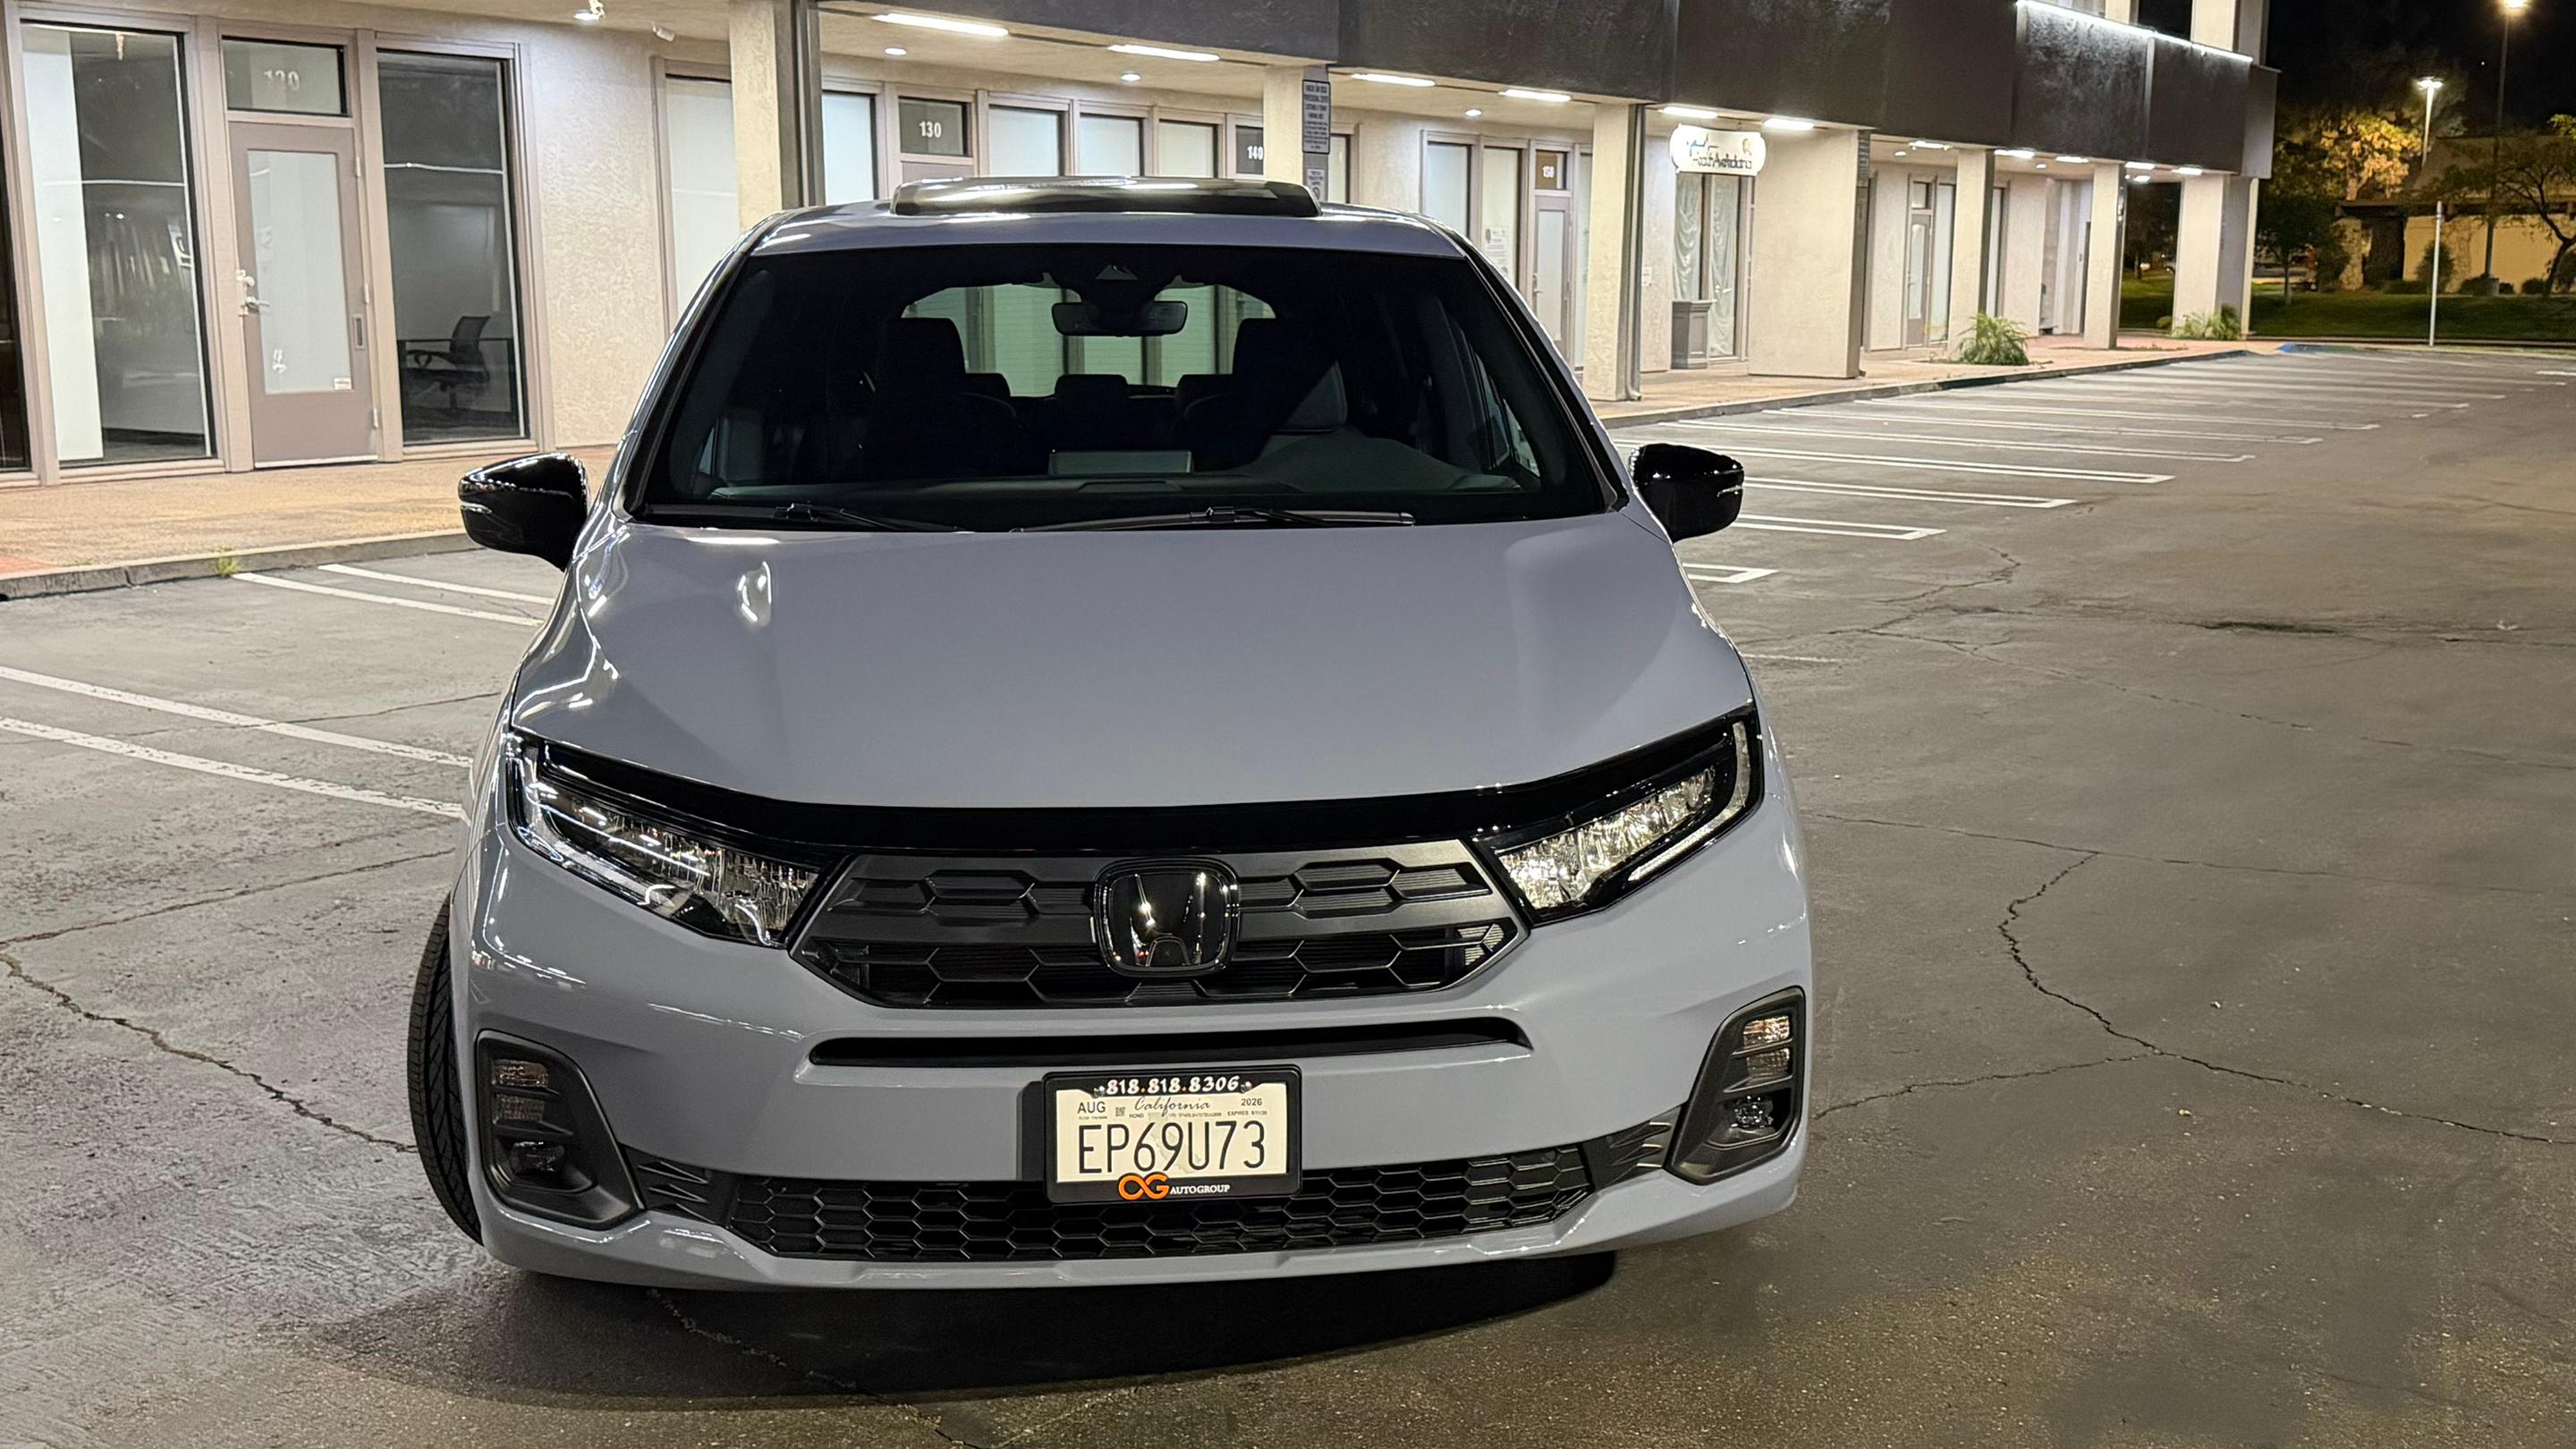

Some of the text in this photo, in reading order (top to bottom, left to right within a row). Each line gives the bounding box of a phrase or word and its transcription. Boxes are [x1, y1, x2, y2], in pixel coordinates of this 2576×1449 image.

[919, 121, 942, 138] 130
[1247, 145, 1263, 160] 140
[1106, 1076, 1240, 1095] 818.818.8306
[1077, 1101, 1106, 1114] AUG
[1134, 1097, 1211, 1116] California
[1241, 1098, 1263, 1106] 2026
[1078, 1120, 1266, 1174] EP69U73
